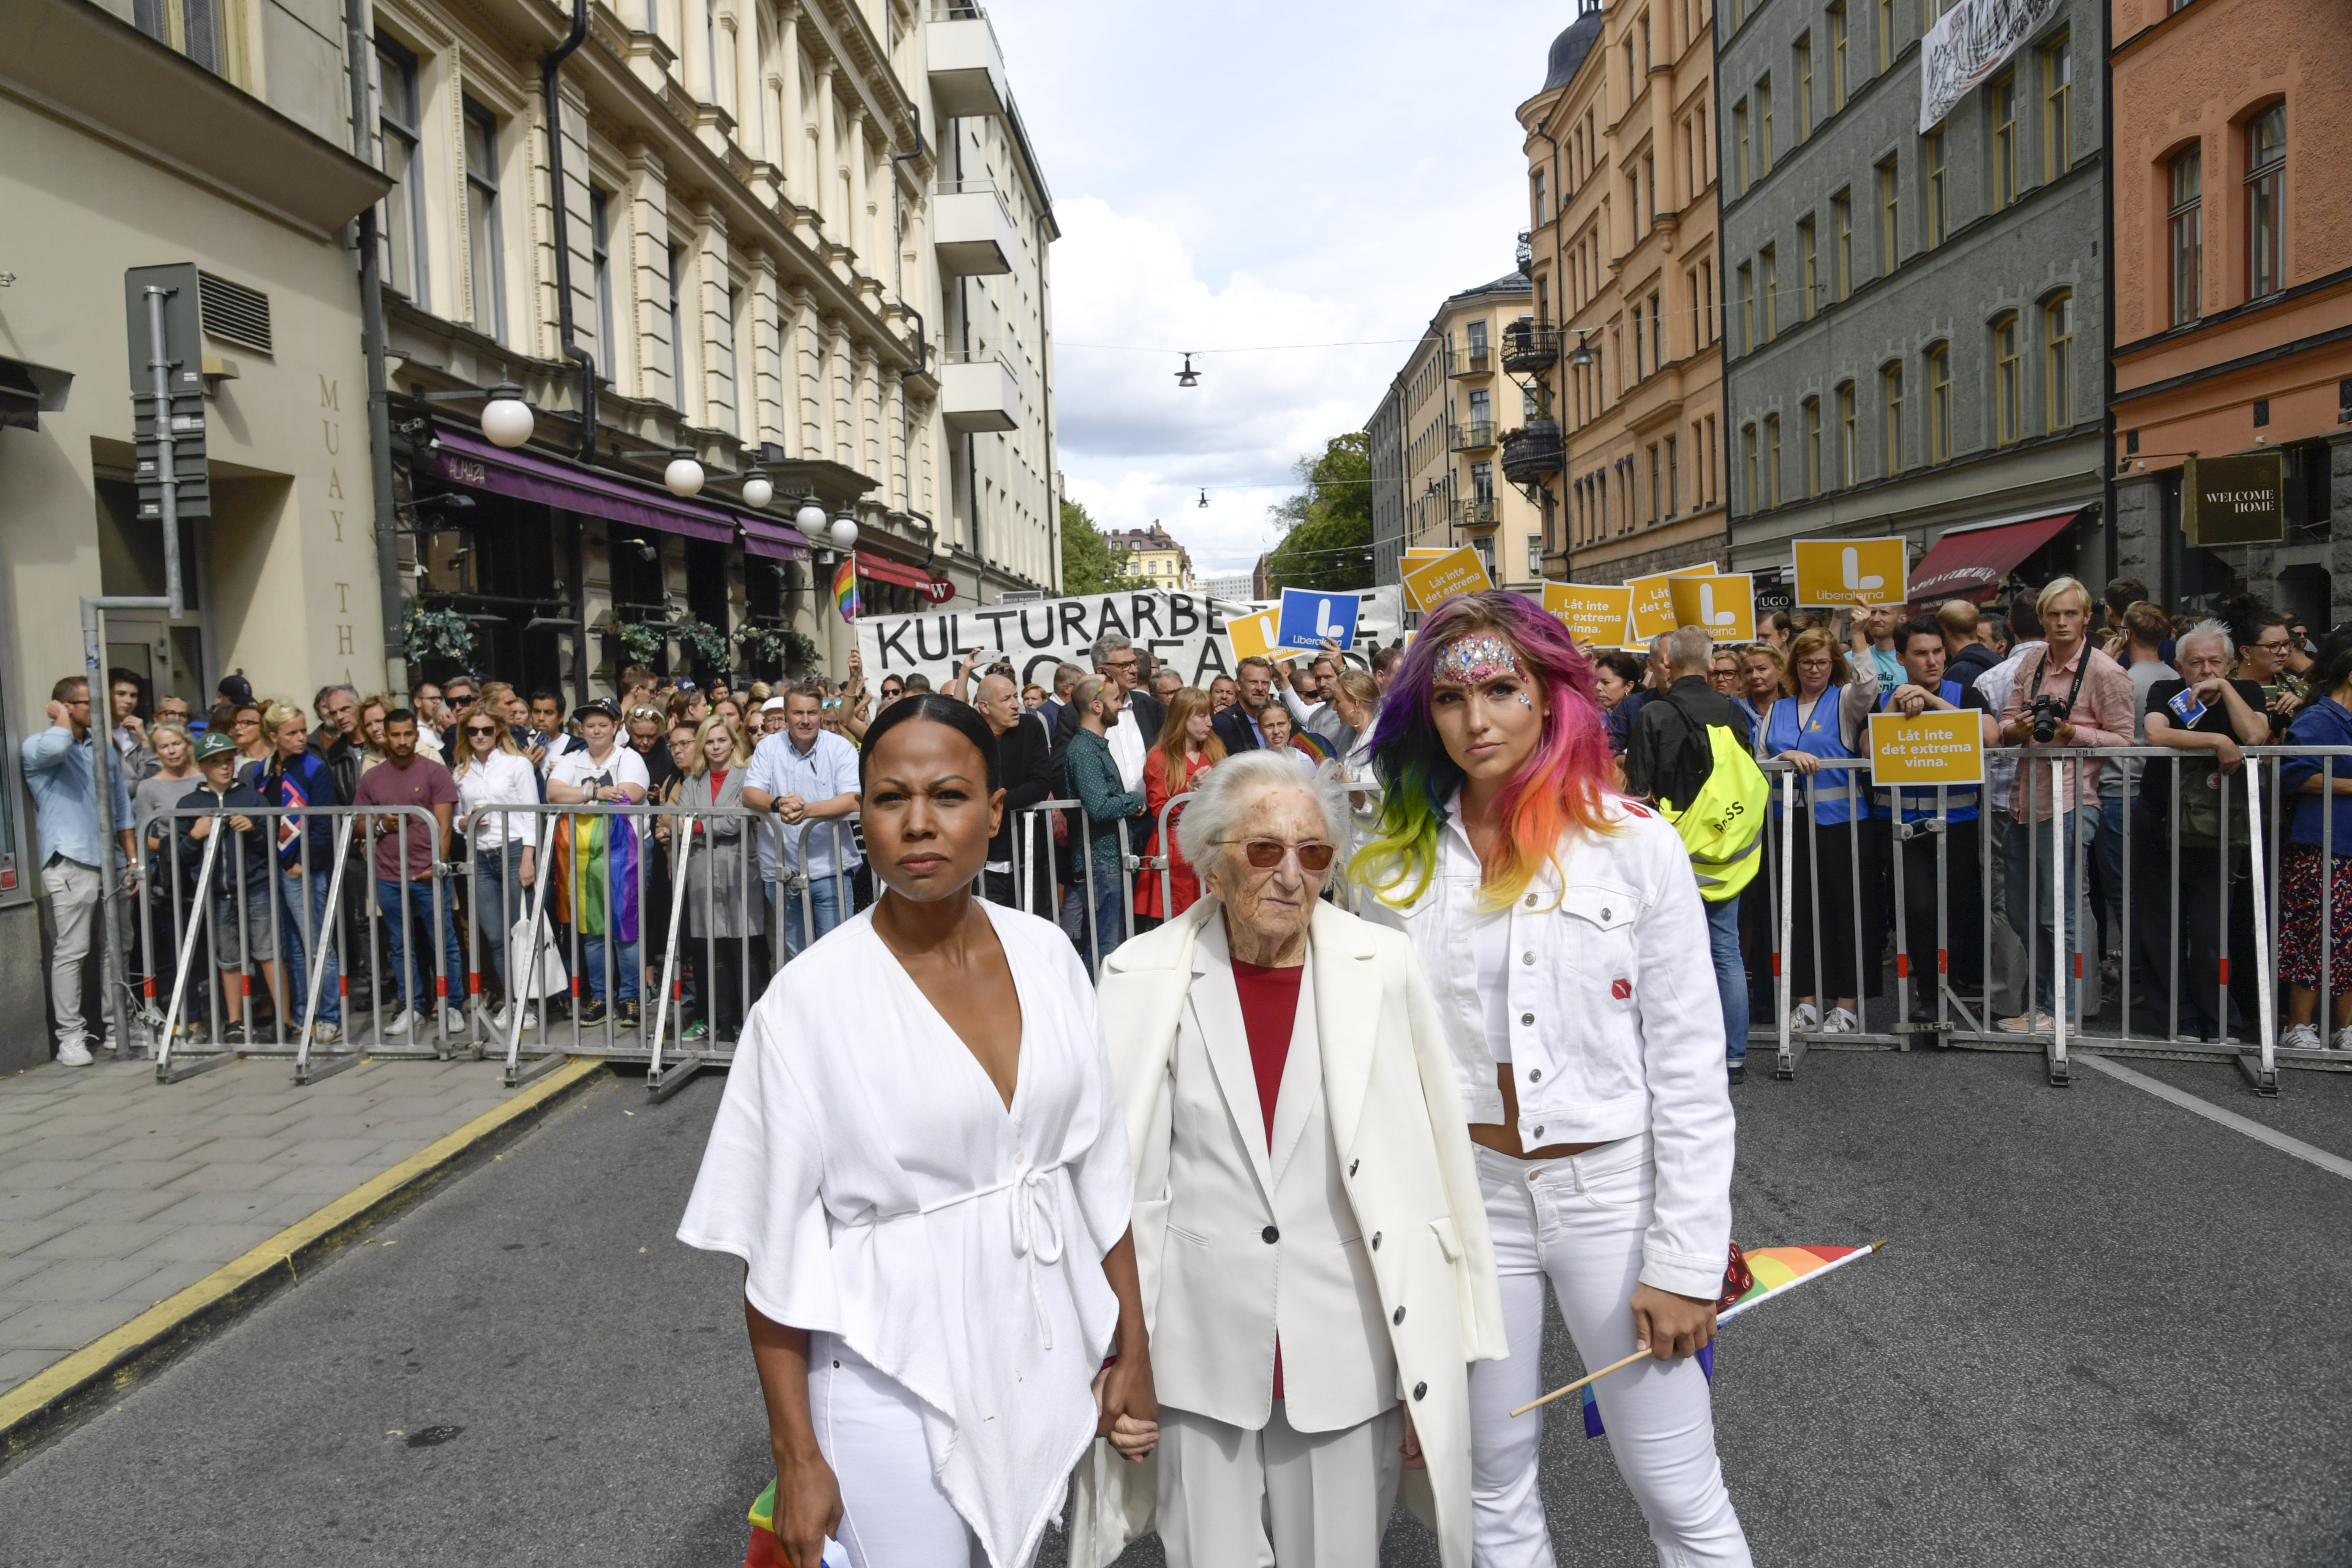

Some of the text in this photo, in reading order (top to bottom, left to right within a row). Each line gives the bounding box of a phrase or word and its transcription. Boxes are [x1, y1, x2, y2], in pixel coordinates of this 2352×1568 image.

[318, 373, 344, 542] MUAY
[2206, 489, 2274, 503] WELCOME
[2234, 501, 2275, 513] HOME
[1429, 568, 1465, 588] Låt inte
[931, 583, 947, 599] W
[1426, 573, 1481, 603] det extrema
[1650, 588, 1669, 599] Låt
[1761, 596, 1788, 606] UGO
[1816, 590, 1884, 600] Liberalerna
[1564, 599, 1609, 610] Låt inte
[1639, 602, 1660, 613] det
[1550, 608, 1621, 622] det extrema
[1567, 623, 1601, 633] vinna.
[1707, 627, 1736, 637] alerna
[1293, 634, 1342, 647] Liberalea
[2173, 696, 2188, 713] Hata
[1897, 729, 1953, 741] Låt inte
[1881, 743, 1971, 755] det extrema
[1905, 756, 1948, 767] vinna.
